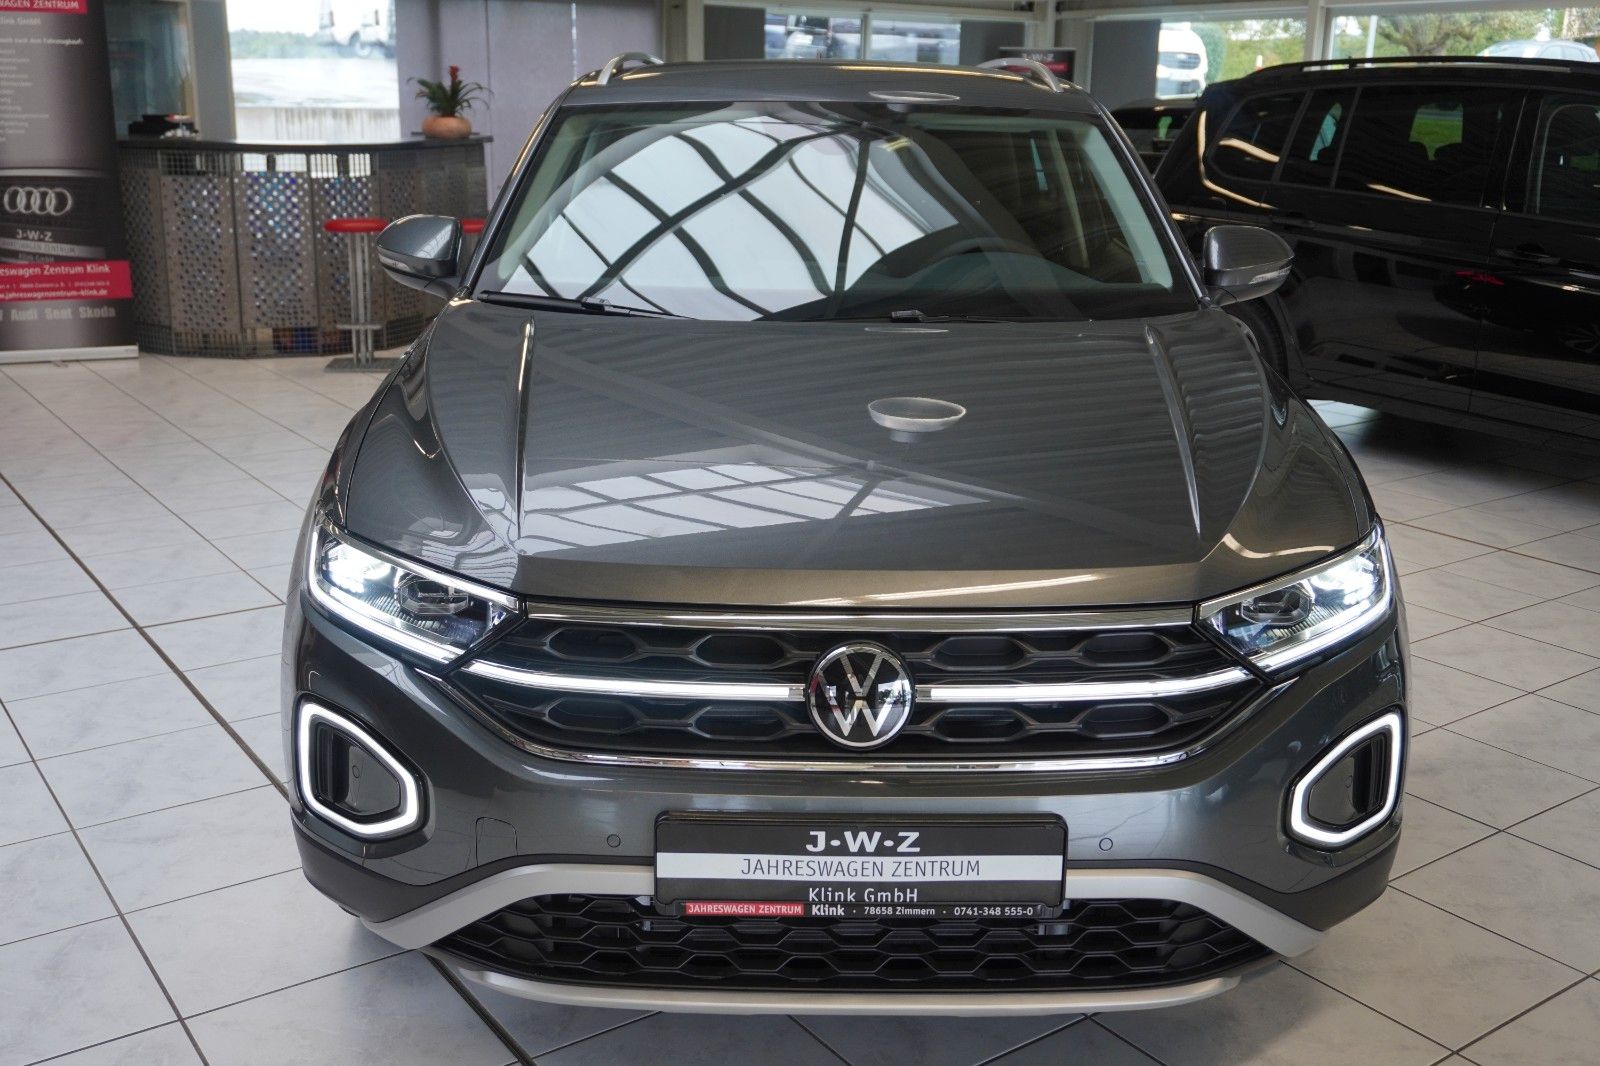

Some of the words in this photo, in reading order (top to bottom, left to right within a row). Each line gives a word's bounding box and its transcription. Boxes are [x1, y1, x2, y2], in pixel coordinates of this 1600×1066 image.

[33, 0, 80, 9] ZENTRUM
[43, 264, 84, 275] Zentrum
[86, 263, 110, 274] Klink
[11, 309, 38, 320] Audi
[79, 305, 116, 318] Skoda
[741, 858, 884, 877] JAHRESWAGEN
[891, 860, 980, 877] ZENTRUM
[808, 887, 857, 902] Klink
[864, 888, 918, 902] GmbH
[688, 904, 756, 914] JAHRESWAGEN
[758, 904, 801, 914] ZENTRUM
[811, 905, 845, 916] Klink
[864, 906, 893, 915] 78658
[895, 906, 936, 915] Zimmern
[954, 906, 1001, 916] 0741-348
[1004, 906, 1034, 916] 555-0
